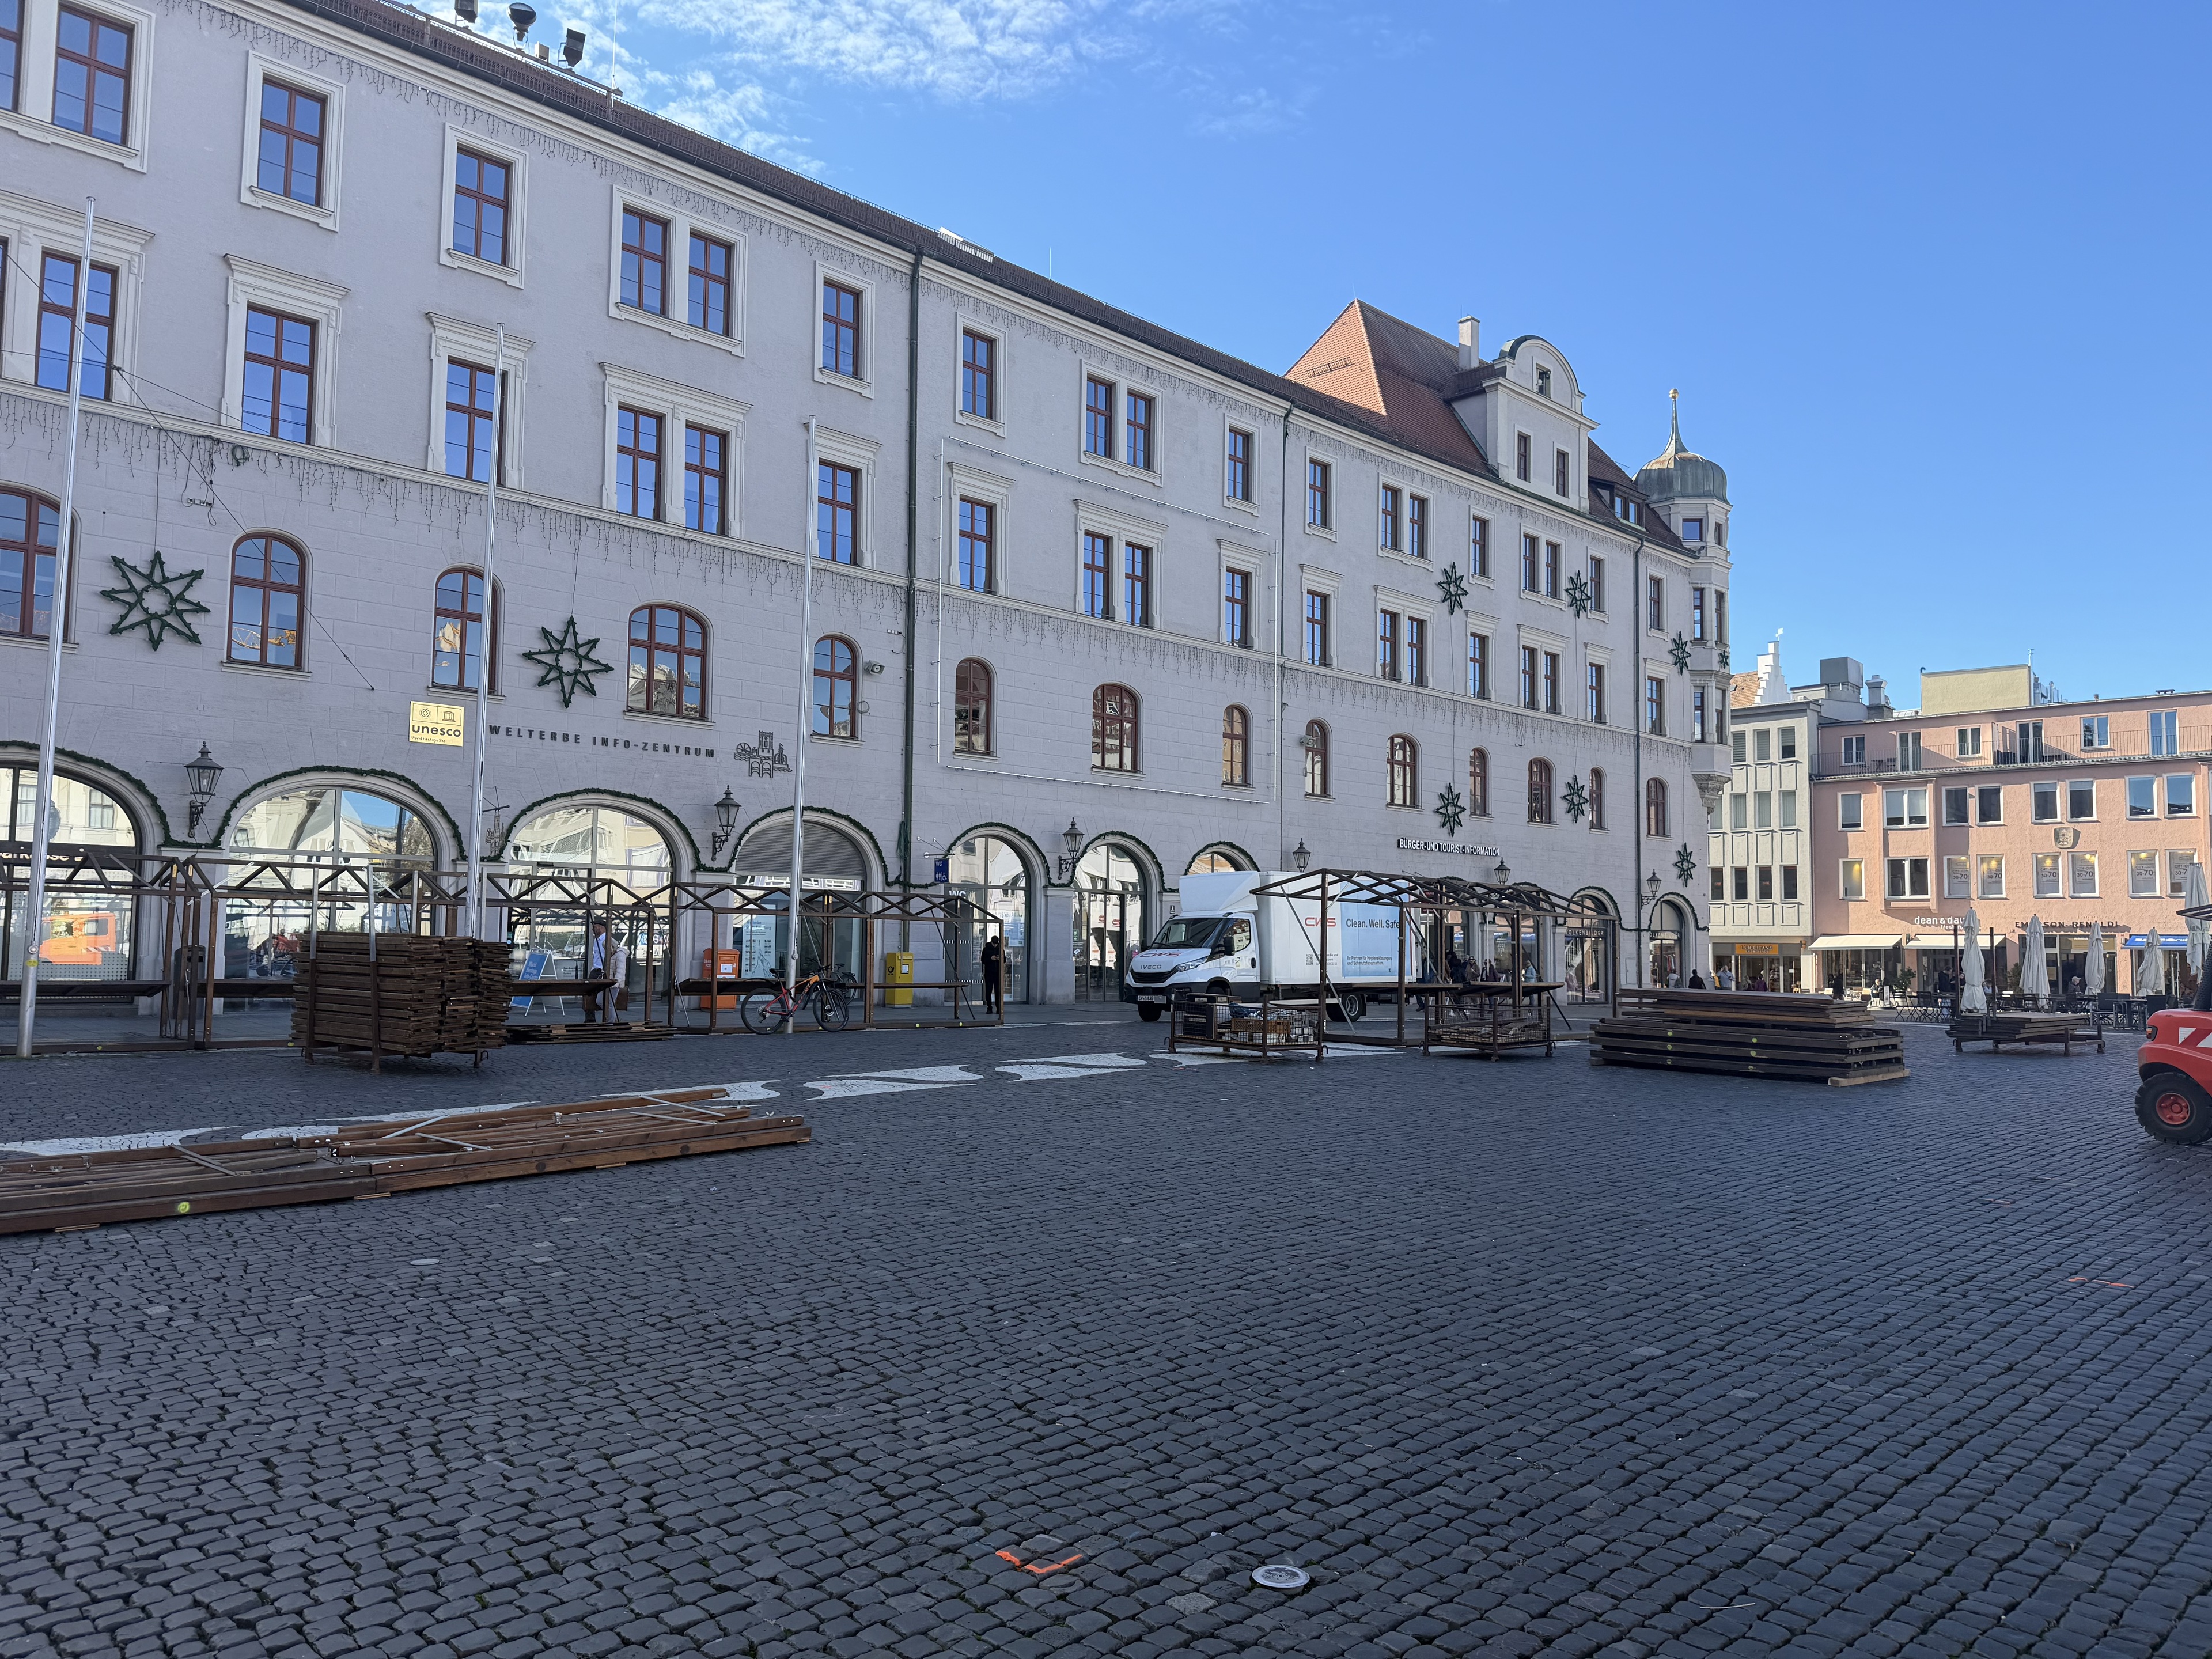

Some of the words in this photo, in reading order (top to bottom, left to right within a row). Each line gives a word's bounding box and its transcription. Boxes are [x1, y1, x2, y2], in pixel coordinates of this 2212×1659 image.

[412, 725, 461, 737] unesco
[489, 725, 581, 744] WELTERBE
[593, 737, 714, 757] INFO-ZENTRUM
[1440, 843, 1500, 856] TOURIST-INFORMATION
[949, 890, 966, 899] WC
[1346, 918, 1368, 928] Clean.
[1369, 919, 1384, 929] Well.
[1914, 916, 1938, 925] dean
